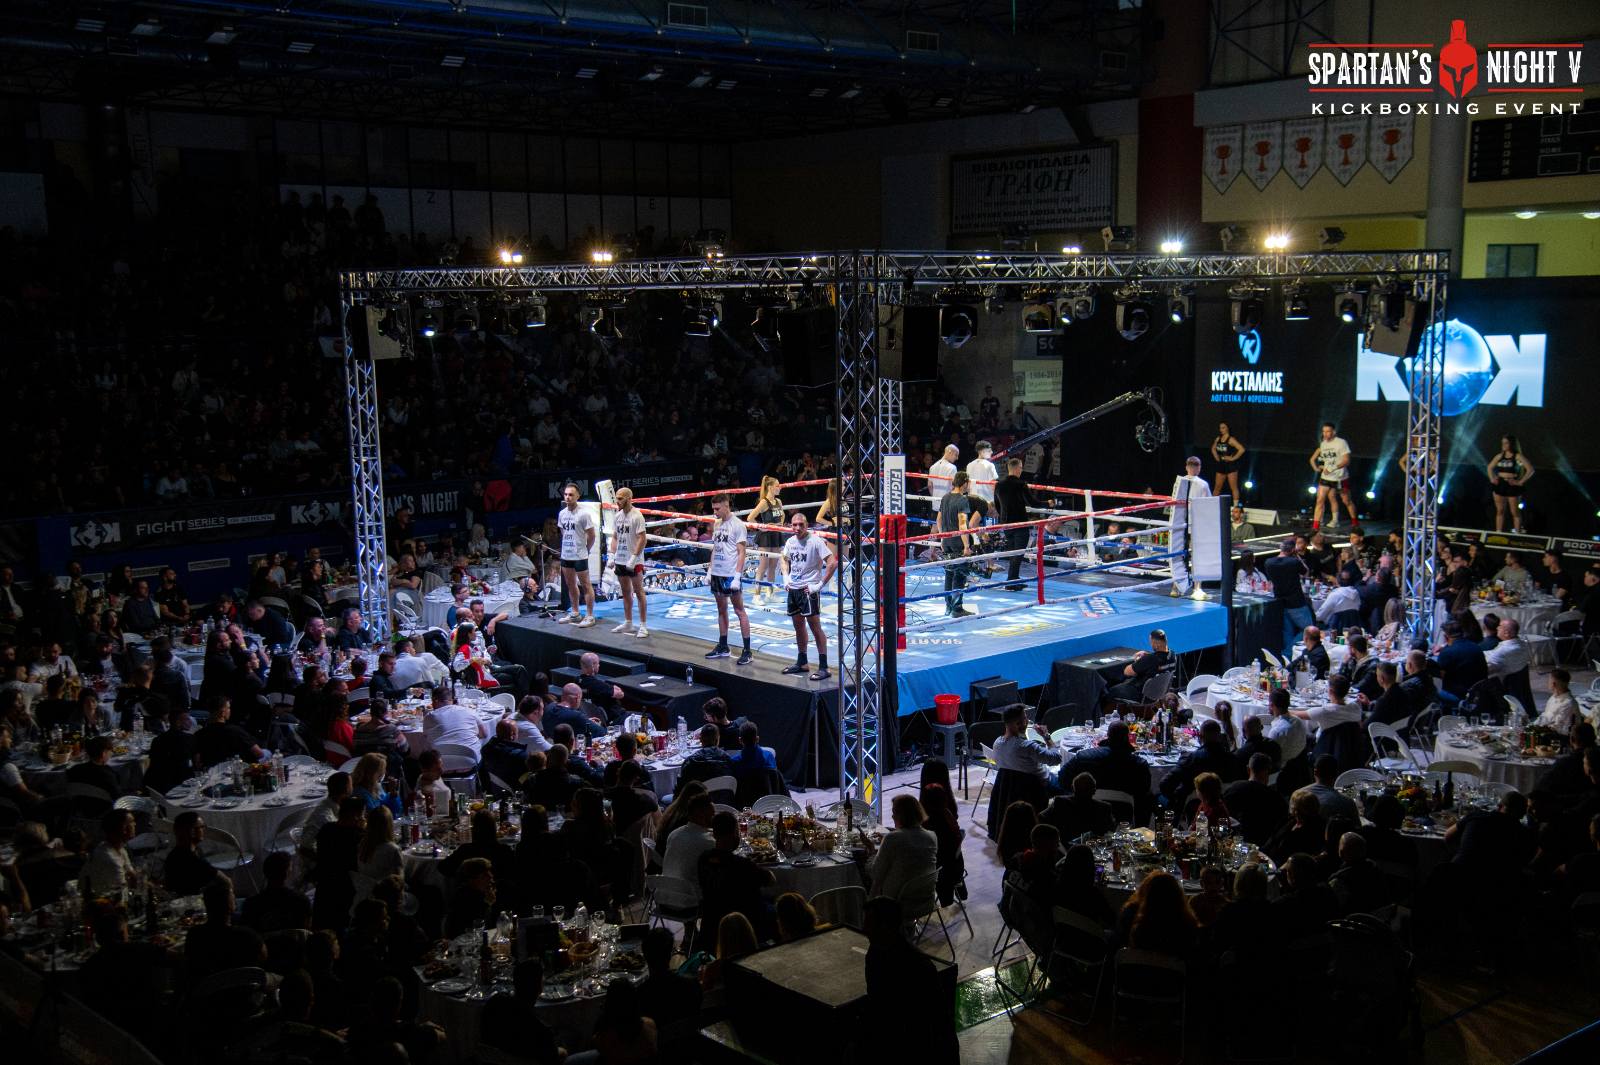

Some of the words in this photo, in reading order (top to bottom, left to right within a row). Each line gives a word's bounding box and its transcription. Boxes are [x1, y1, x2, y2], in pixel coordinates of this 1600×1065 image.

[421, 491, 459, 514] NIGHT
[136, 520, 186, 536] FIGHT
[187, 516, 226, 531] SERIES
